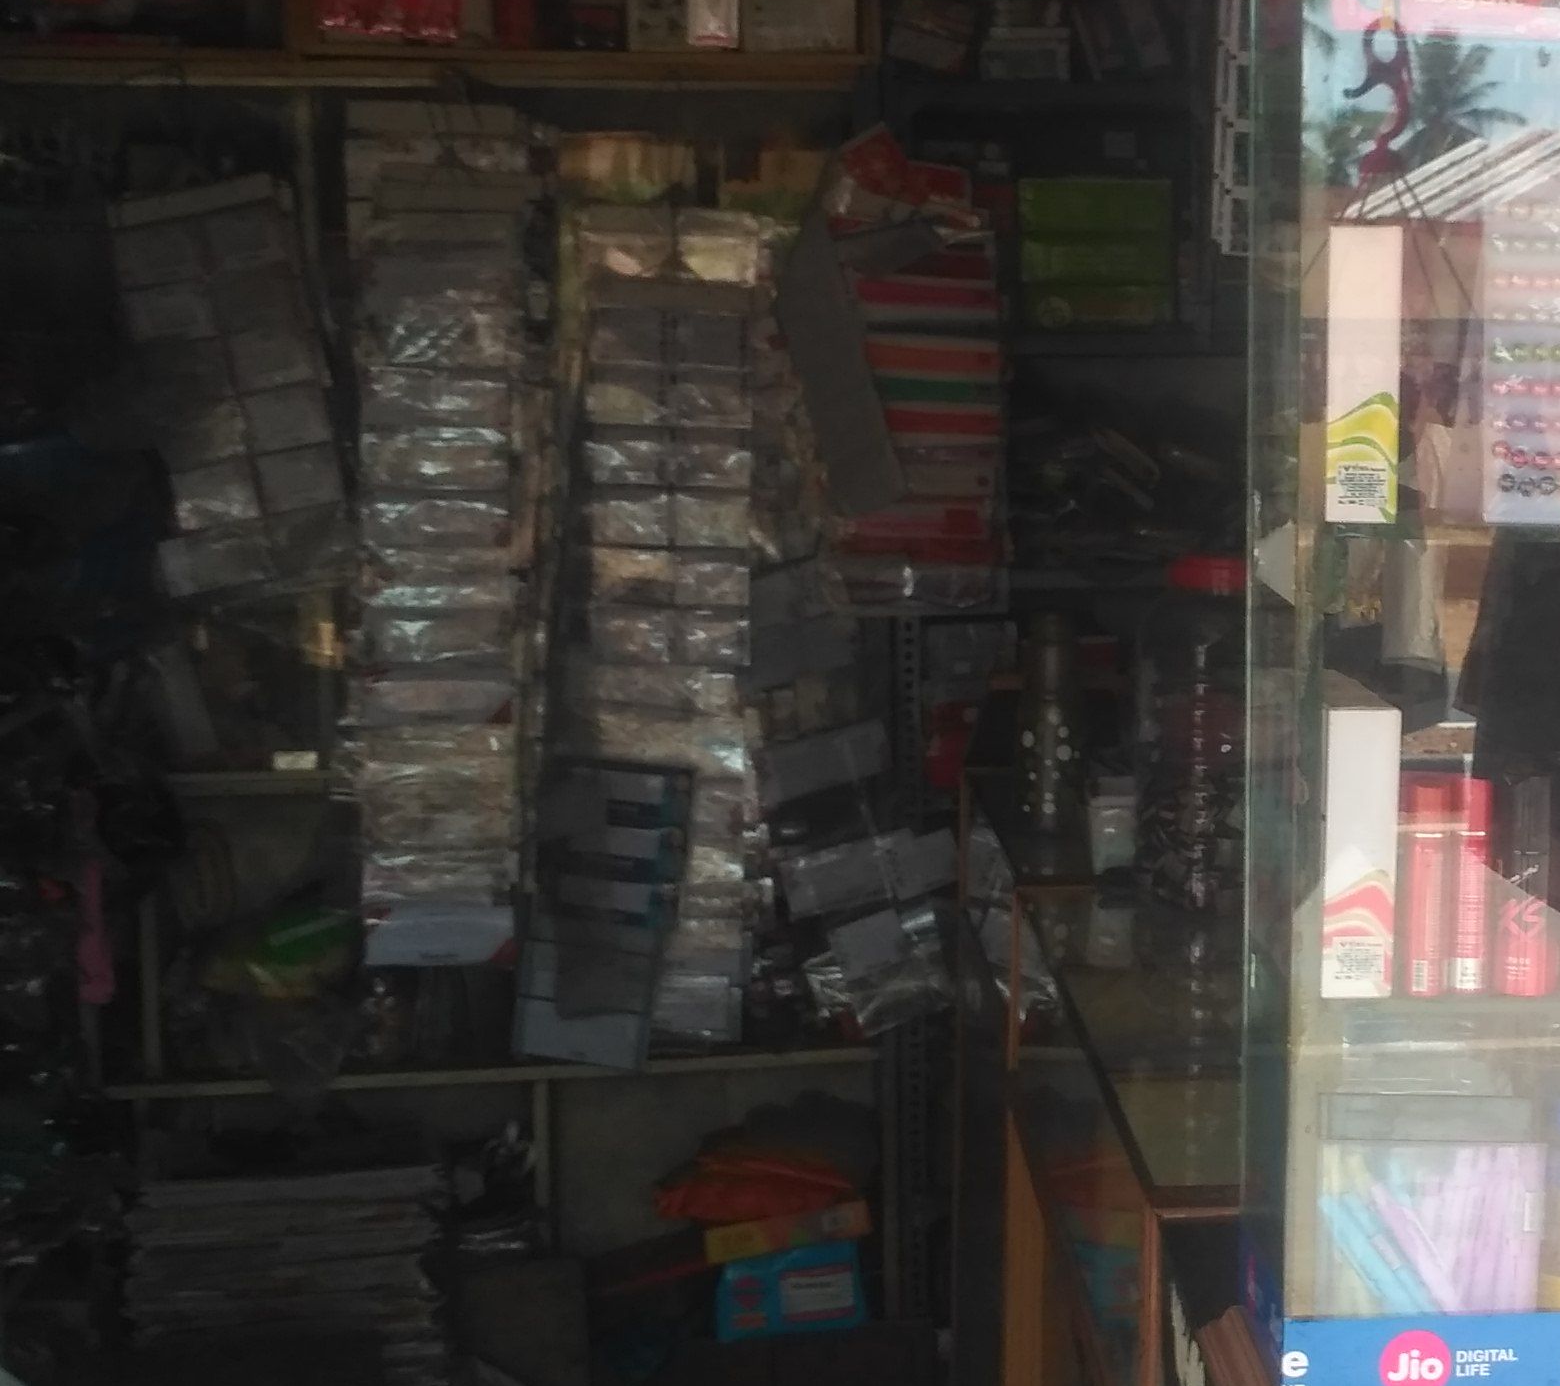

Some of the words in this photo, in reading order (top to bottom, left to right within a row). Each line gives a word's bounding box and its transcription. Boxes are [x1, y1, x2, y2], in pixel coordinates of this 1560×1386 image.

[1455, 1347, 1519, 1364] DIGITAL
[1386, 1348, 1444, 1383] Jio
[1455, 1363, 1491, 1377] LIFE
